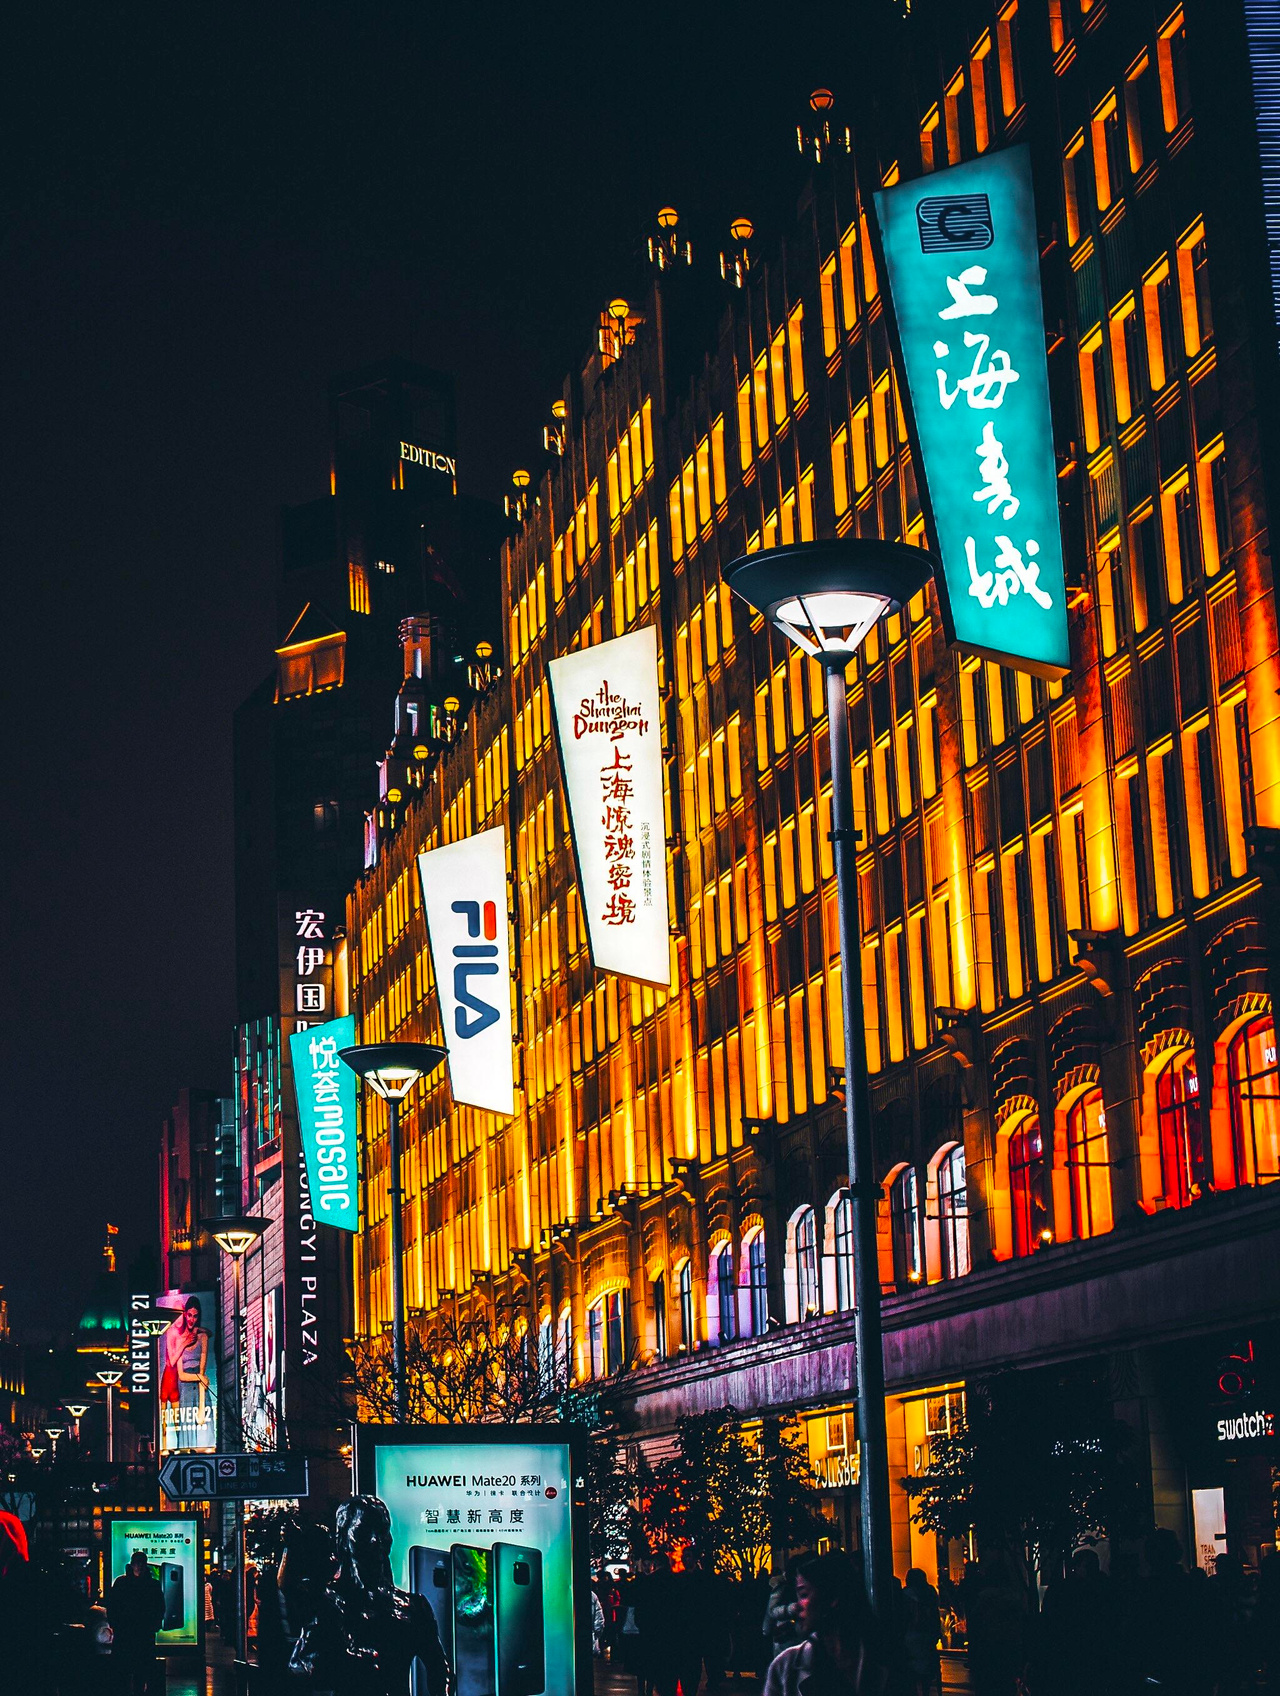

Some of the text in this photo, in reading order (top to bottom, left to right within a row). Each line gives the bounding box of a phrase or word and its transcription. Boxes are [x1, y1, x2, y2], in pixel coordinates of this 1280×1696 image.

[400, 441, 456, 476] EDITION
[596, 680, 621, 704] the
[580, 698, 642, 720] Shanghai
[573, 714, 649, 742] Dungeon
[450, 900, 501, 1040] FILA
[132, 1294, 150, 1310] 21
[300, 1276, 319, 1366] PLAZA
[162, 1407, 199, 1424] FOREVER
[1217, 1411, 1266, 1441] swatch
[406, 1475, 541, 1487] HUAWEI Mate20 系列
[425, 1508, 524, 1524] 智慧新高度
